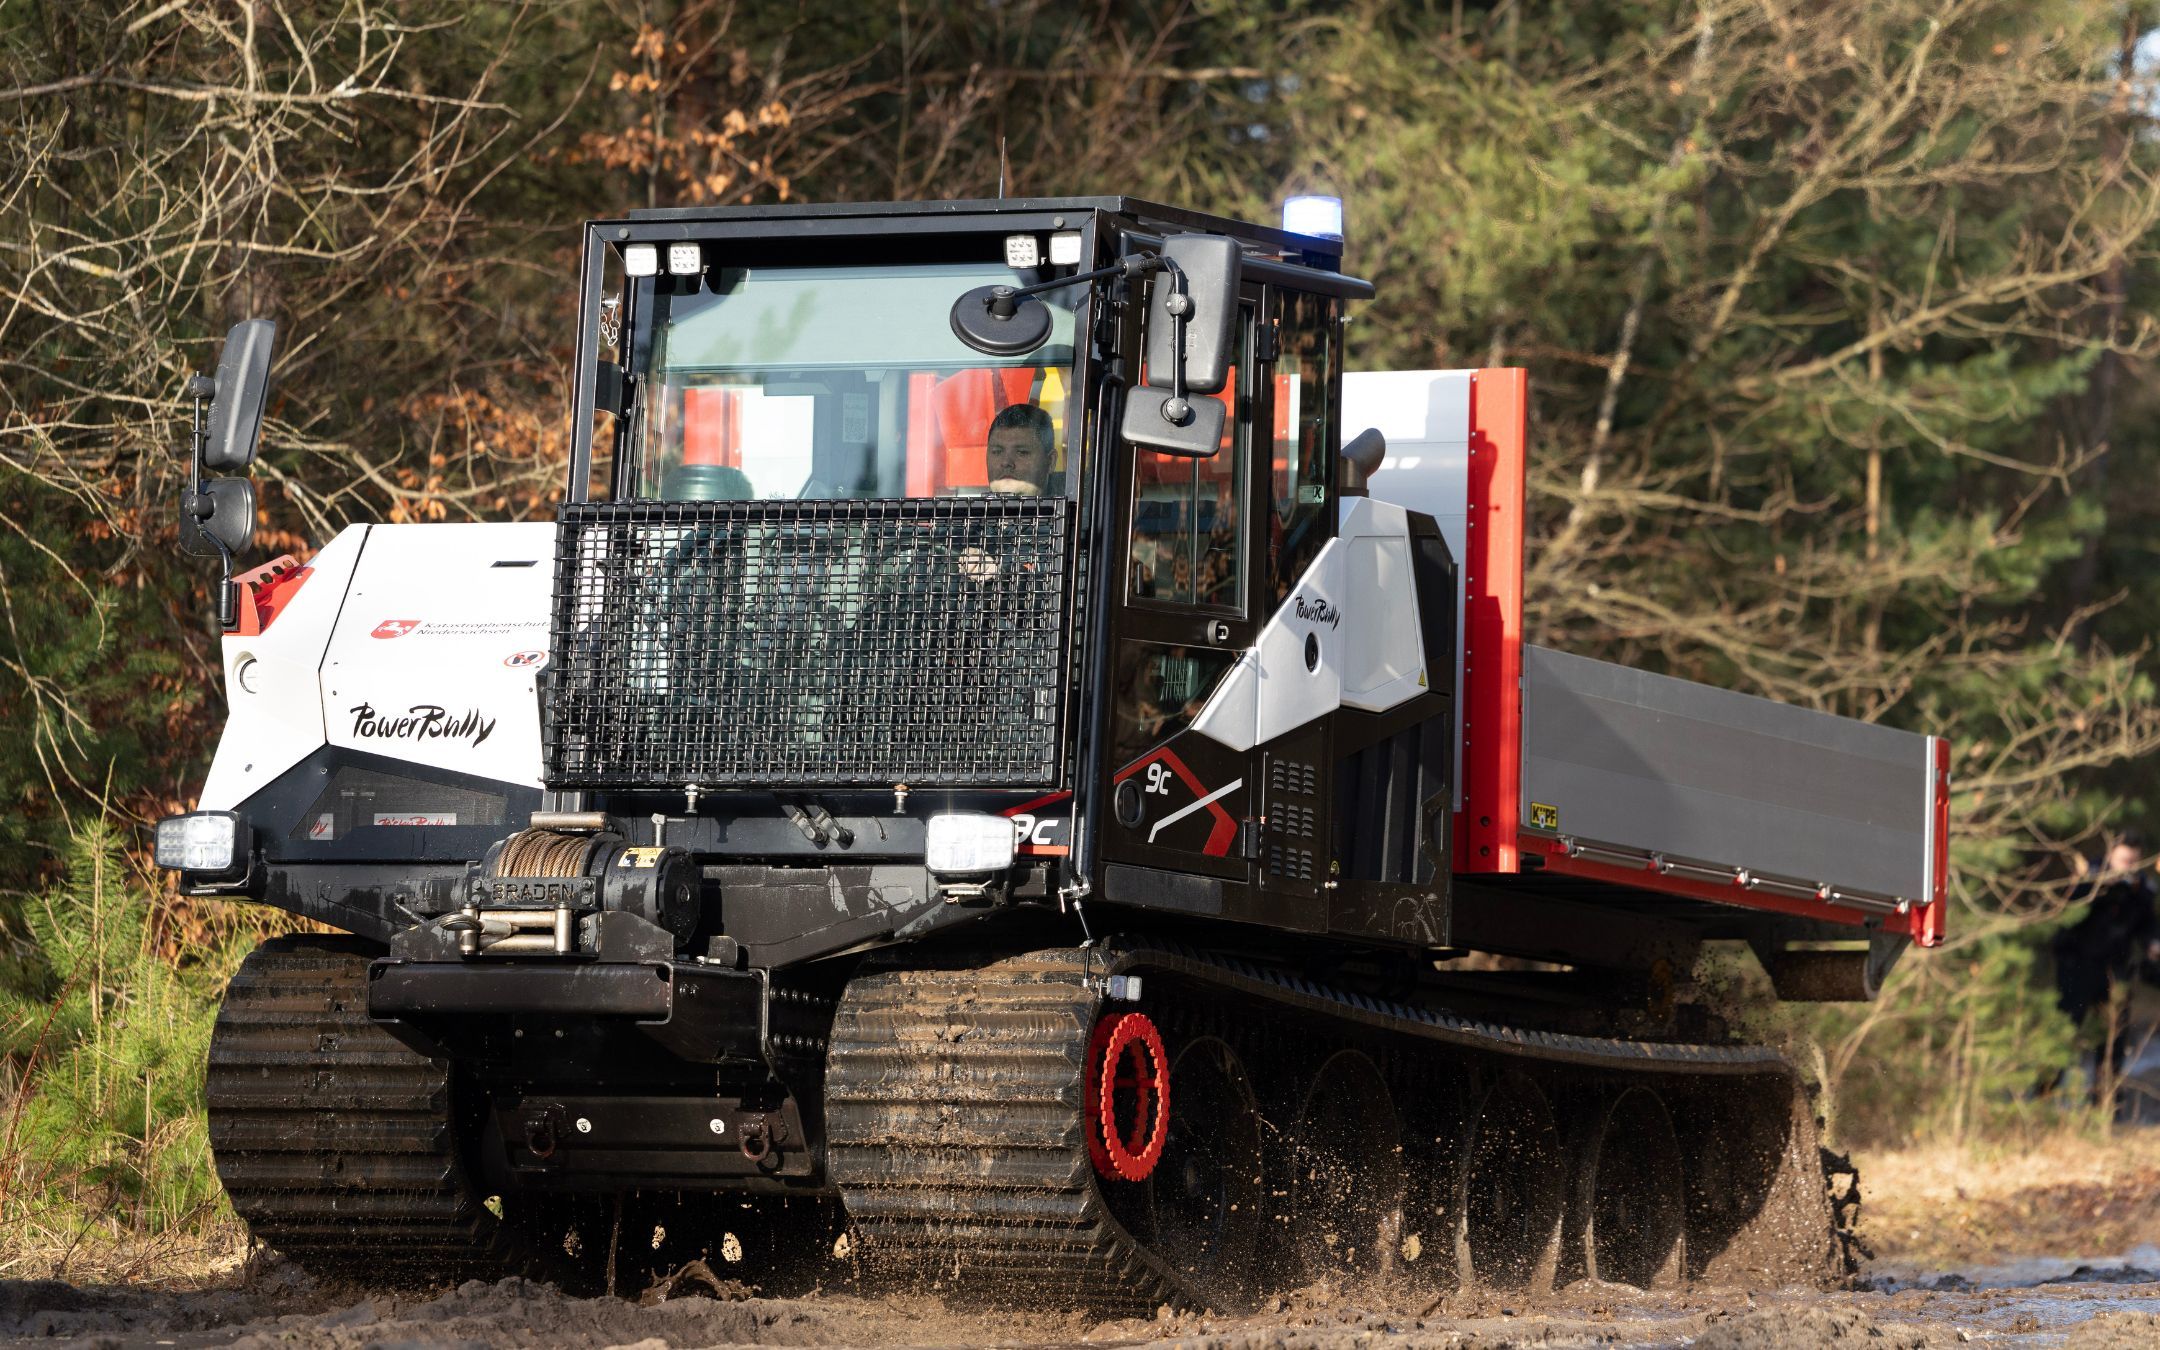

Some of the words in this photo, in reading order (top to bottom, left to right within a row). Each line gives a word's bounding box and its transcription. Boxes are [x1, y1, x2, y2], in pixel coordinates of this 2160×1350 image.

[1296, 594, 1340, 631] PowerBully
[350, 702, 496, 748] PowerBully
[491, 883, 574, 901] BRADEN
